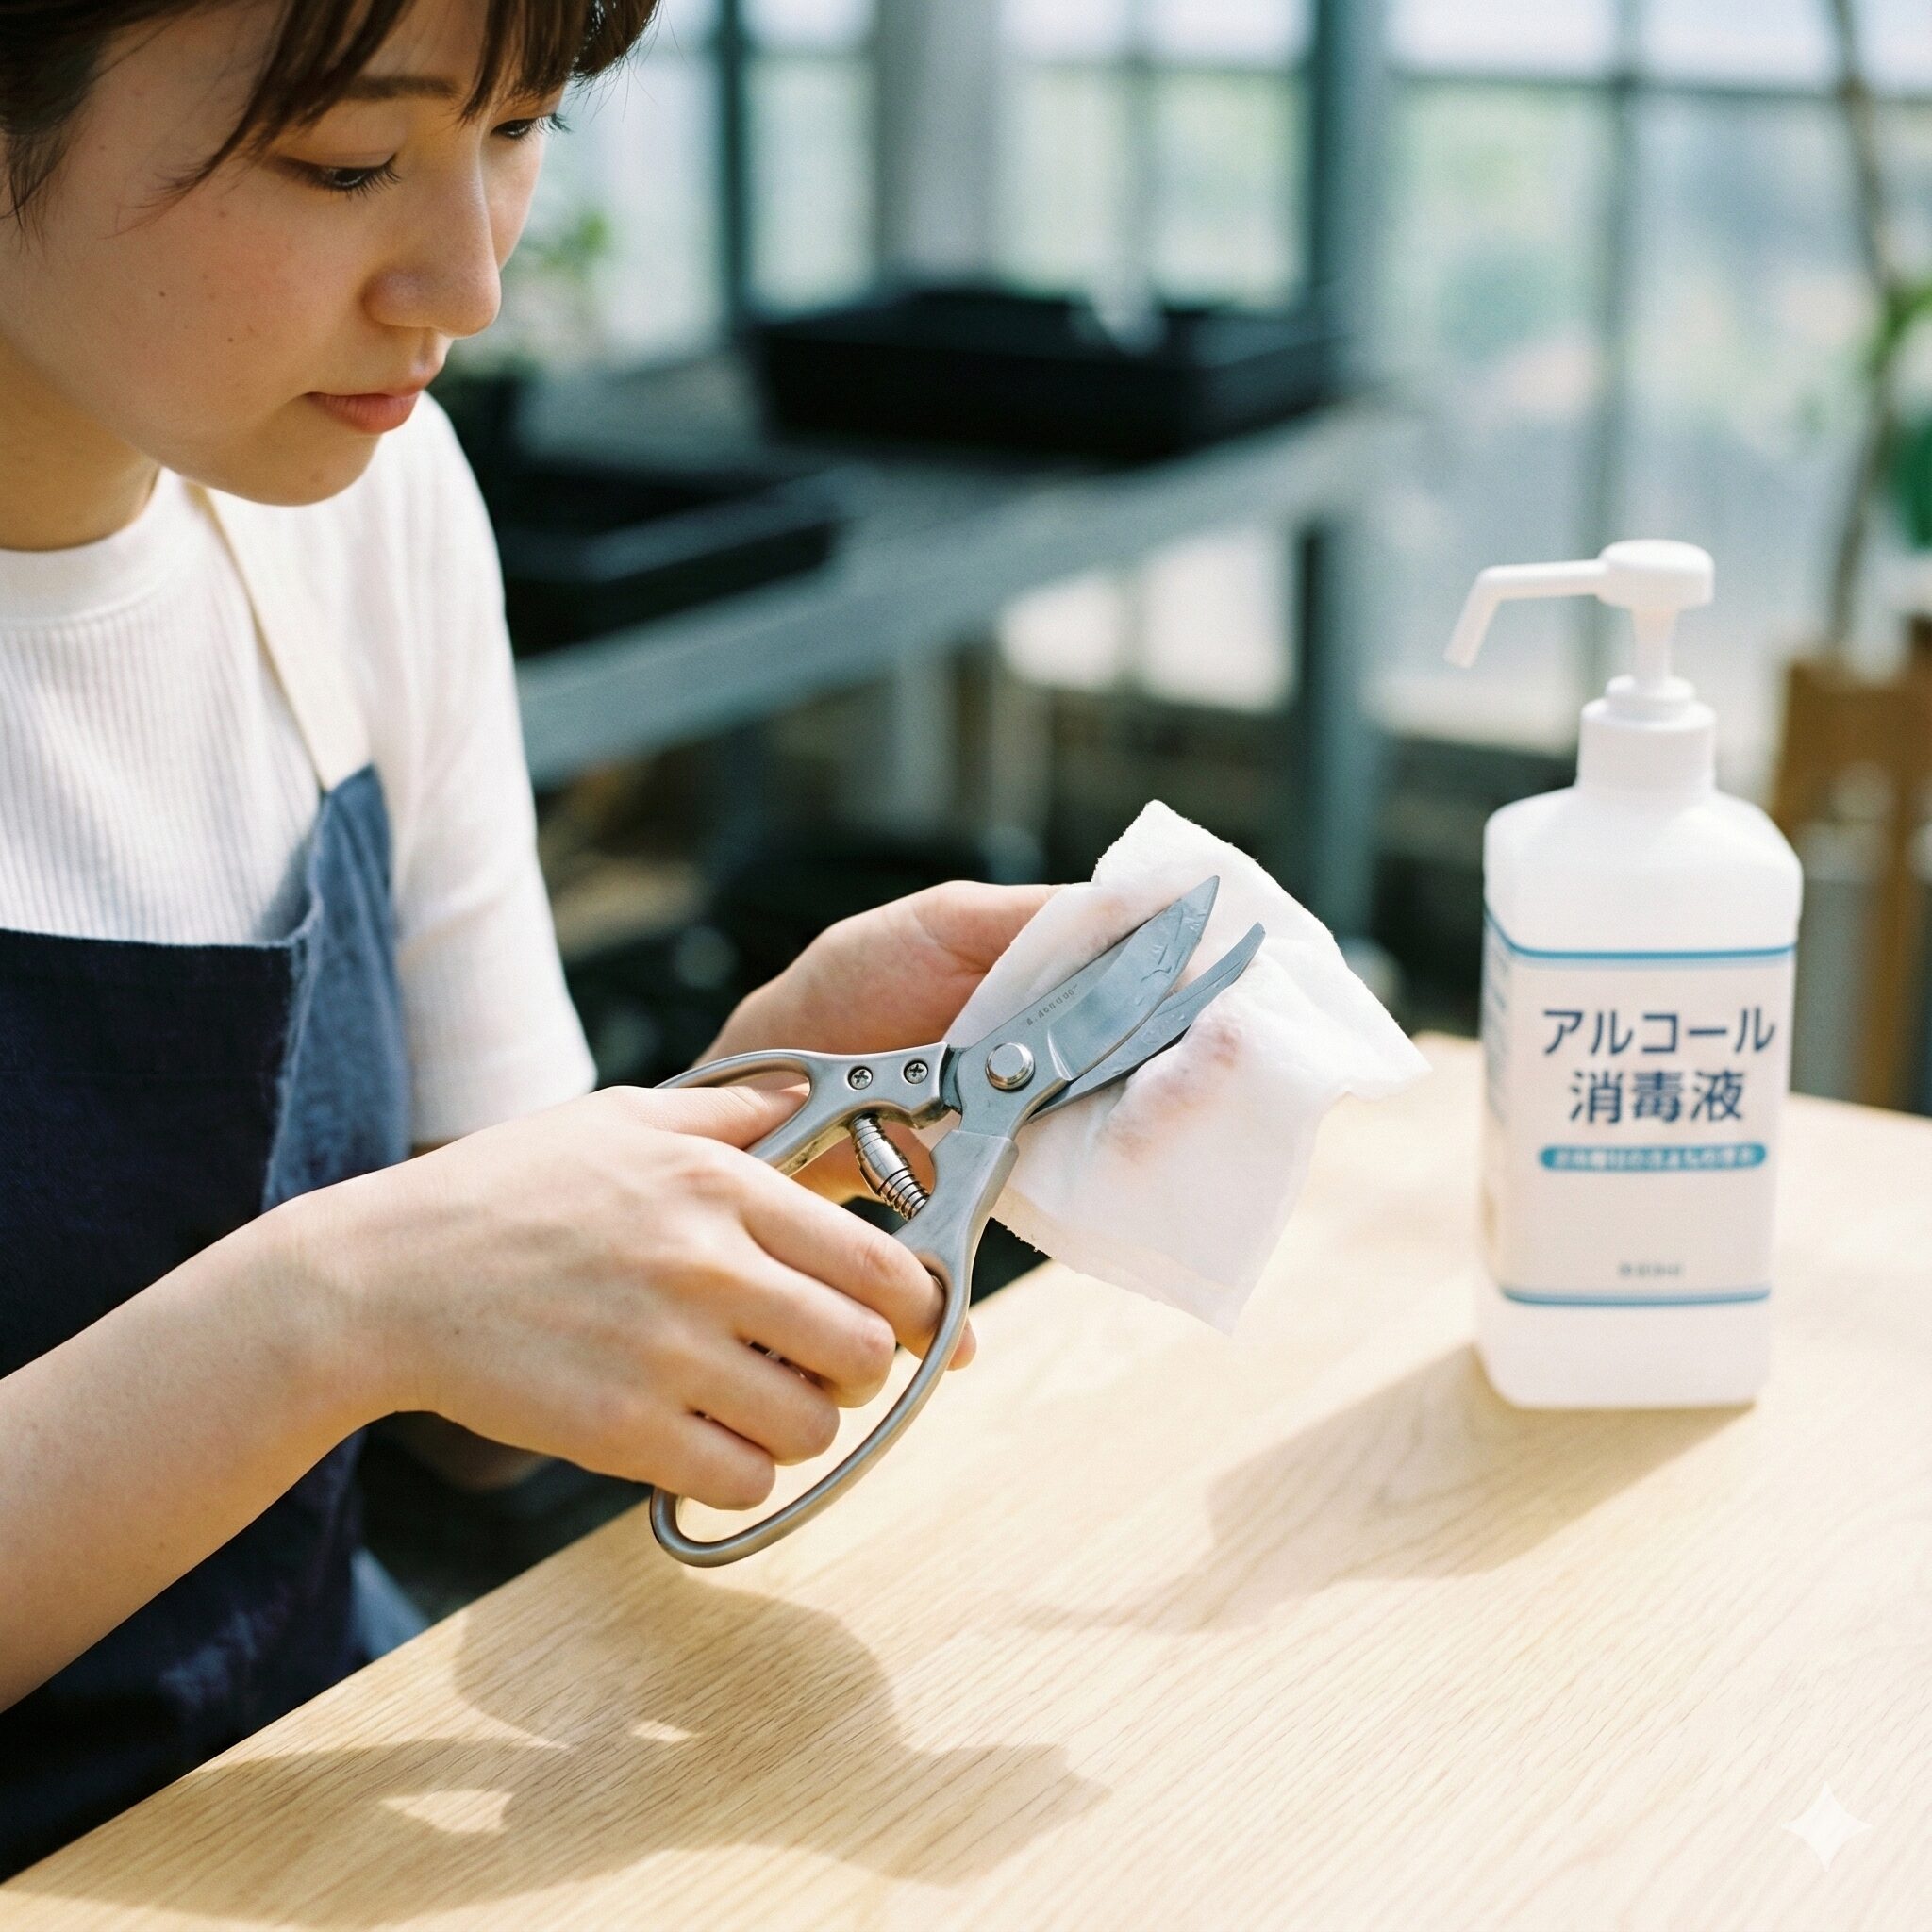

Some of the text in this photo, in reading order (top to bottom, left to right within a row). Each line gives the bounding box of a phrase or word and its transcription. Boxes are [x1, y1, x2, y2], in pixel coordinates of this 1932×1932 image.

[1543, 1008, 1775, 1056] アルコール
[1571, 1069, 1744, 1124] 消毒液
